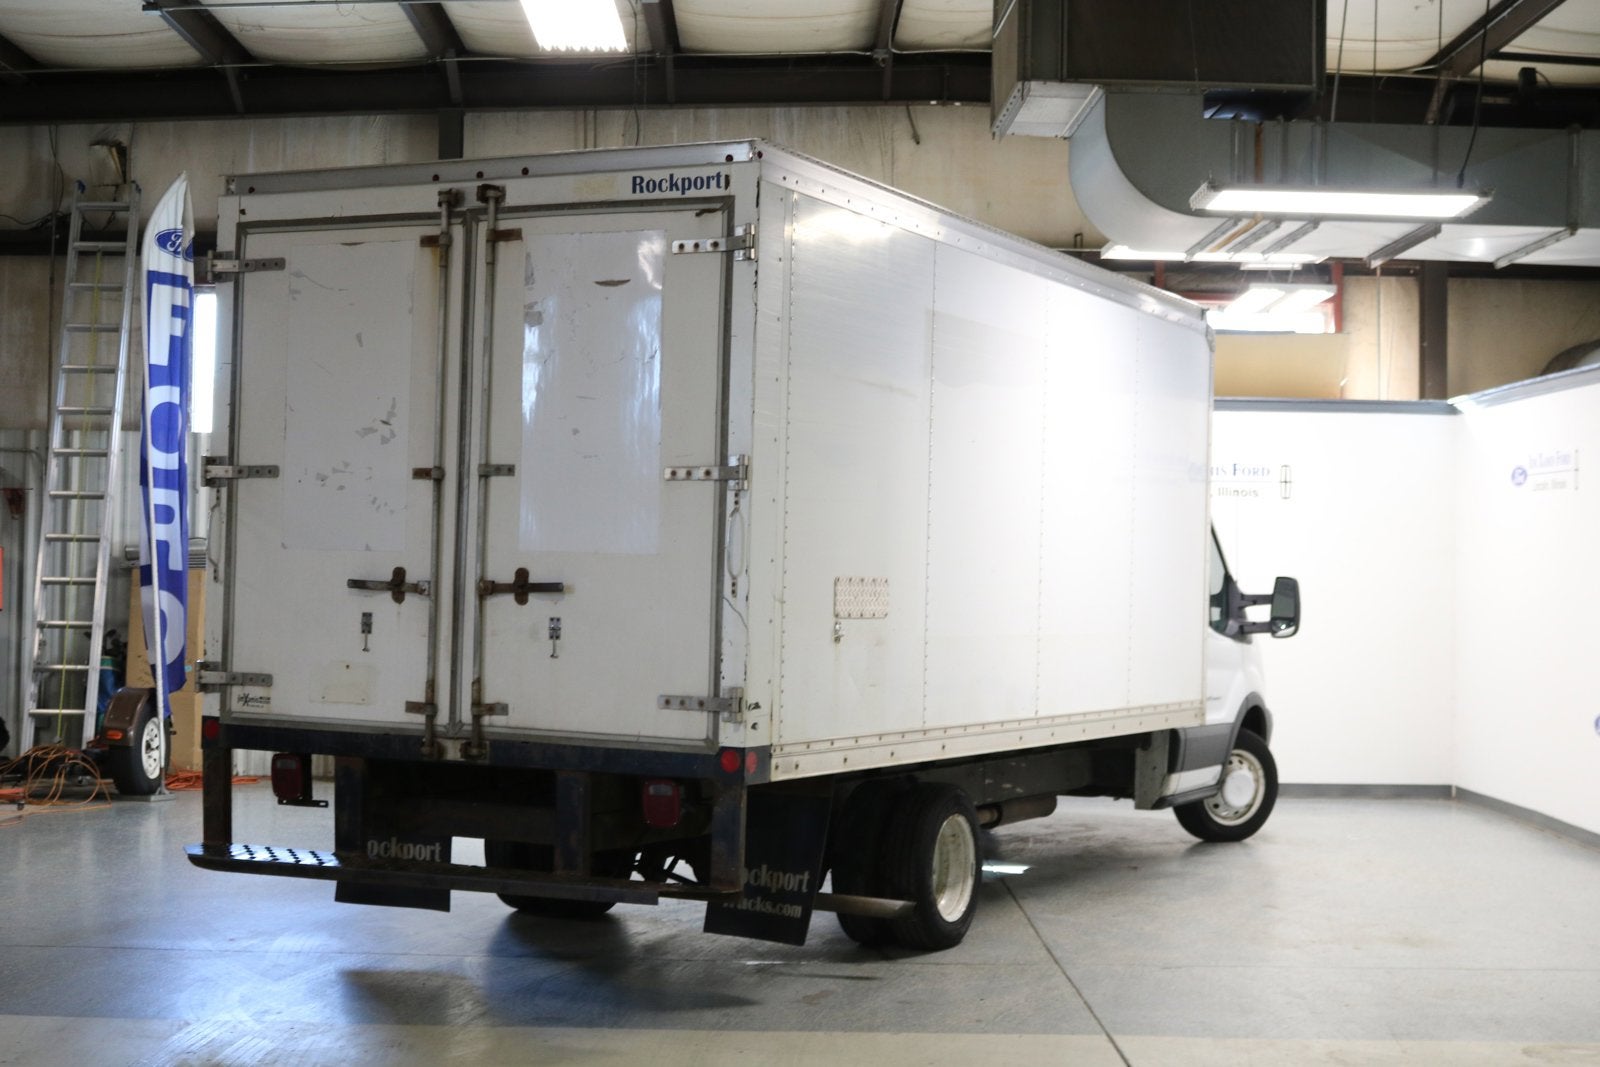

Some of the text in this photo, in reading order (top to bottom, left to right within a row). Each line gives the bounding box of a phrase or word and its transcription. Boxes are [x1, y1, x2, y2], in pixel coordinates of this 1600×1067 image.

[631, 171, 723, 195] Rockport
[1218, 487, 1260, 498] Illinois
[367, 836, 442, 863] ockport
[739, 864, 811, 893] ockport
